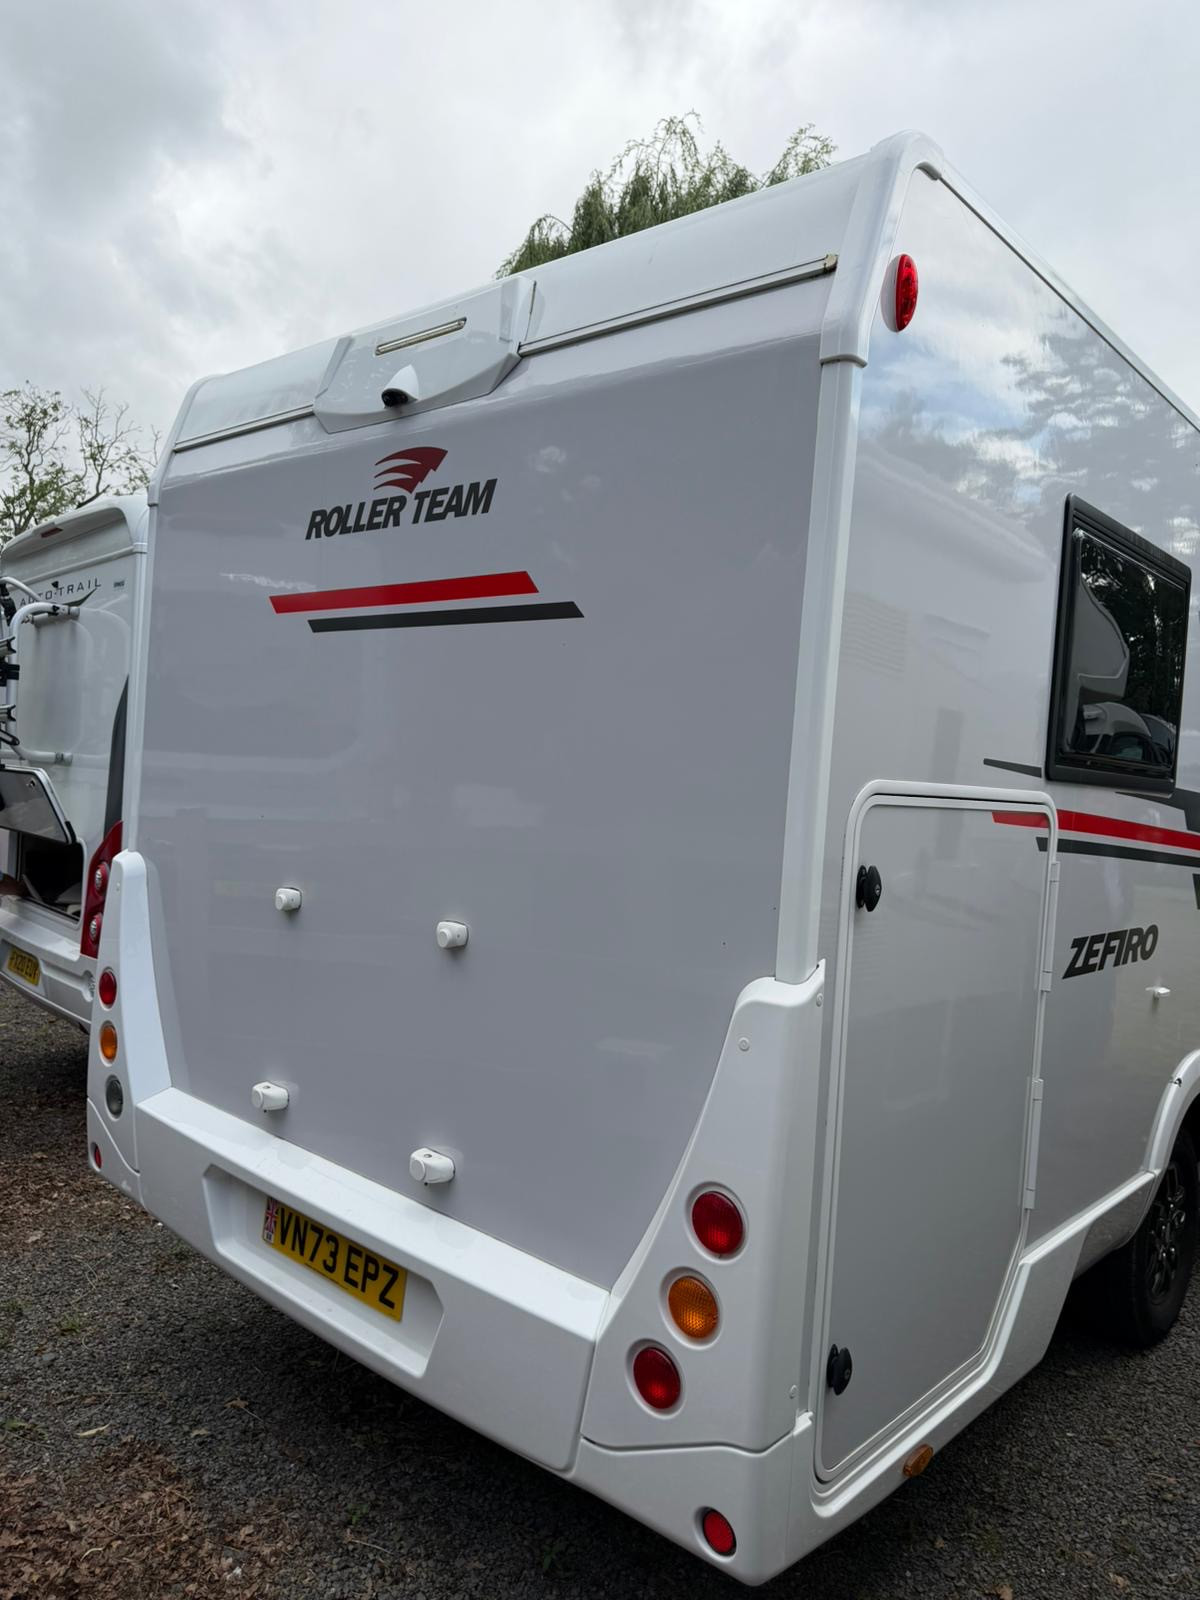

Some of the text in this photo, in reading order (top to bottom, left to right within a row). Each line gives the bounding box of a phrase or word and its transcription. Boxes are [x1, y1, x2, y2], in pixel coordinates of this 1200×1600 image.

[305, 478, 498, 540] ROLLER TEAM
[1062, 924, 1159, 980] ZEFIRO
[280, 1207, 340, 1275] VN73
[344, 1244, 399, 1310] EPZ
